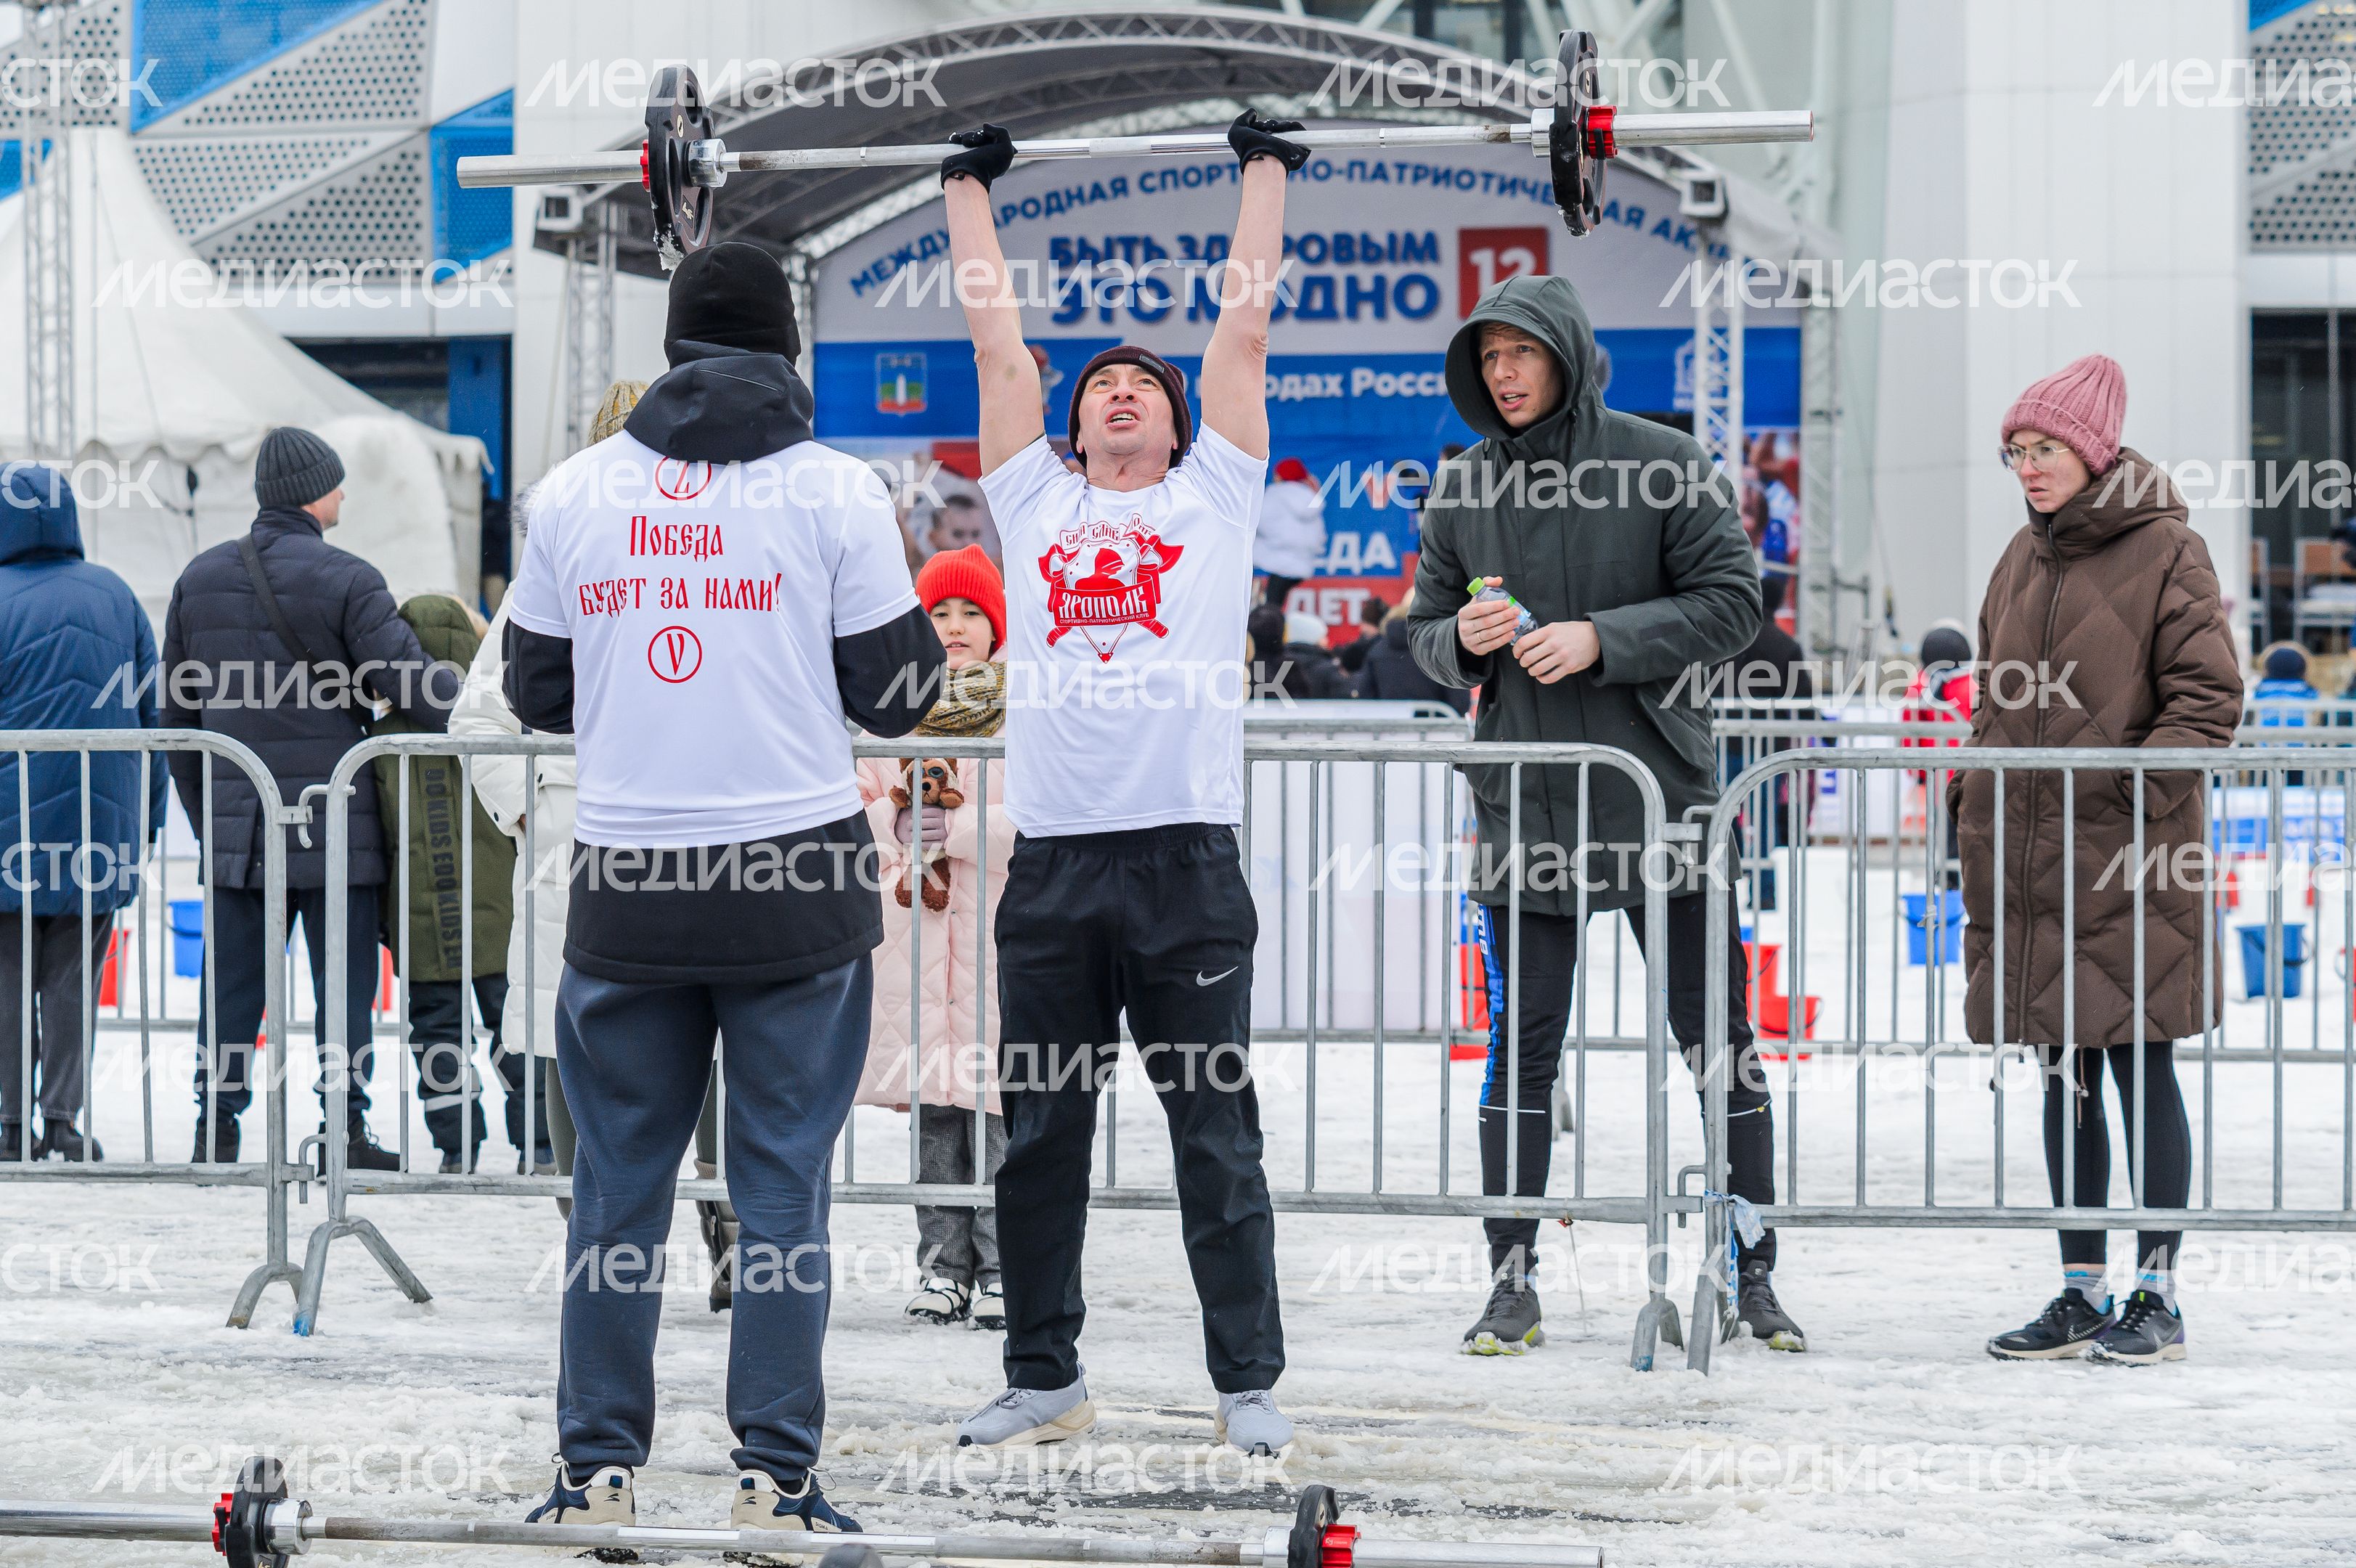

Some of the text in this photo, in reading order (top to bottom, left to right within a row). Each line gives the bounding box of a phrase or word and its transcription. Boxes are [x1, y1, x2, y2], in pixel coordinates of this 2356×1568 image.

[849, 176, 1128, 297] МЕЖДУРОДНАЯ
[1138, 159, 1646, 230] СПОРТНО-ПАТРИОТИЧЕАЯ
[1049, 230, 1440, 269] БЫТЬ ЗДОВЫМ
[1051, 276, 1173, 324] ЭТО
[1265, 372, 1345, 402] одах
[1059, 586, 1148, 618] ЯРОПОЛК
